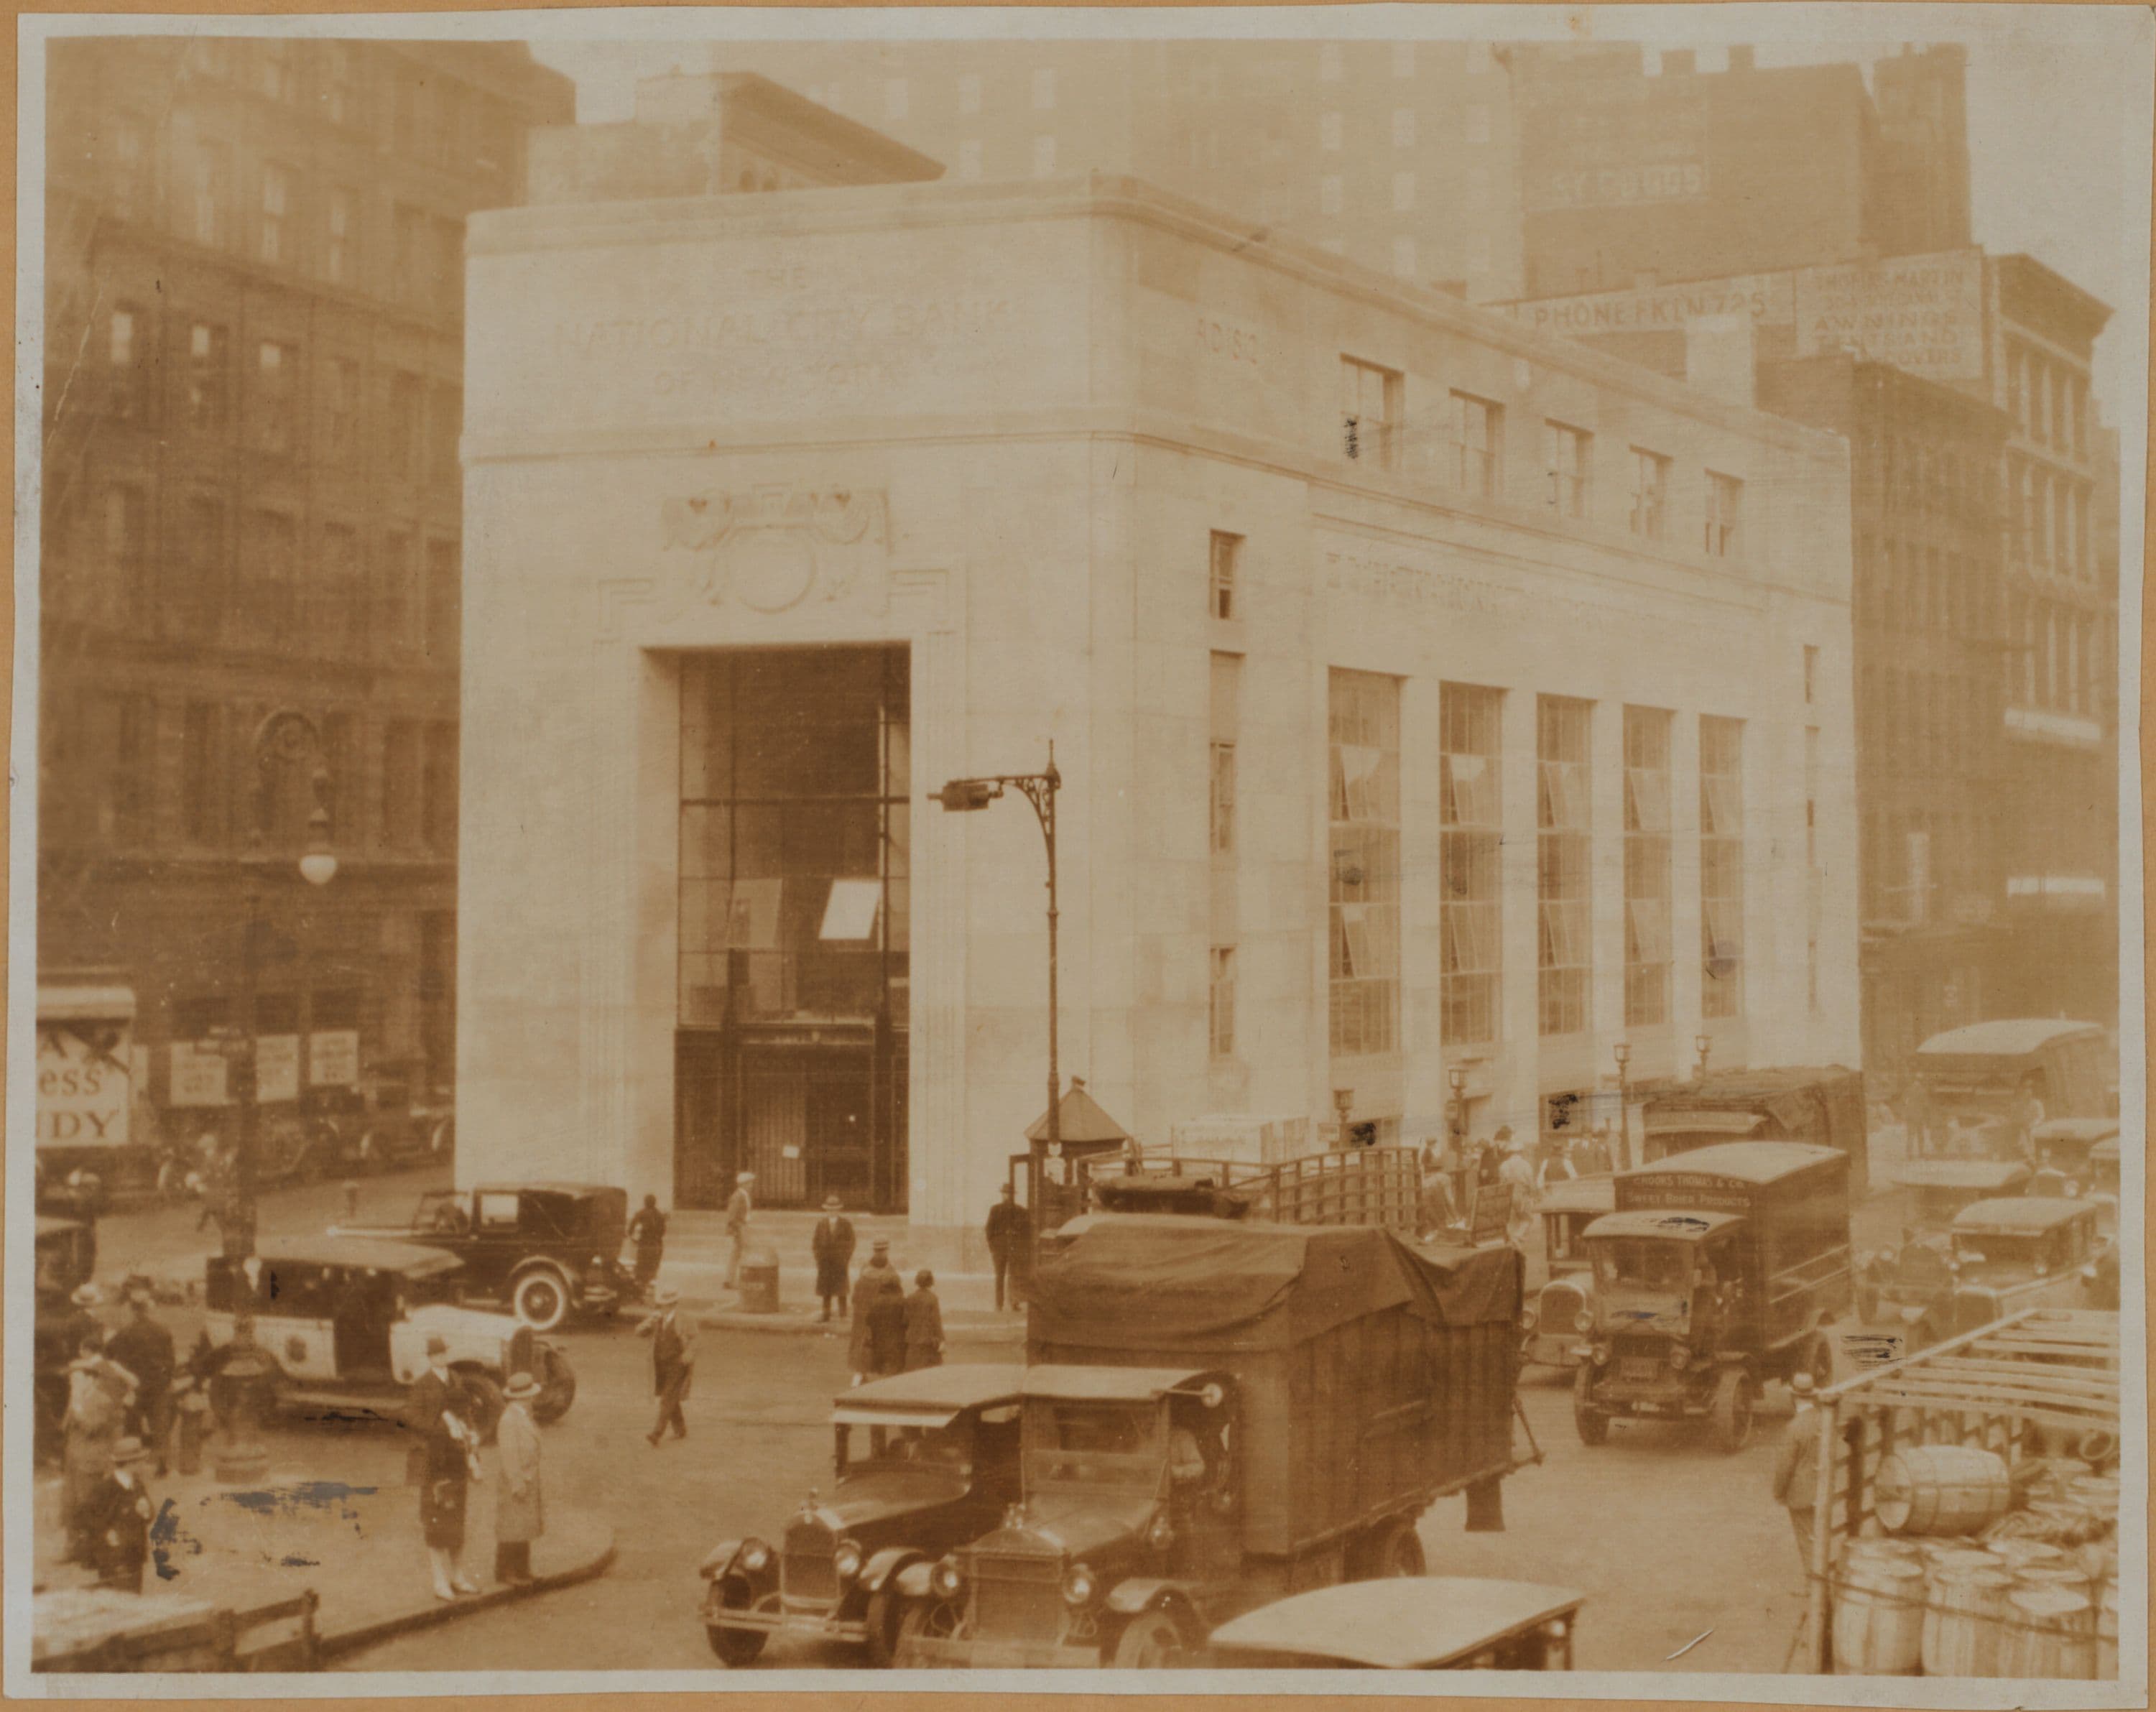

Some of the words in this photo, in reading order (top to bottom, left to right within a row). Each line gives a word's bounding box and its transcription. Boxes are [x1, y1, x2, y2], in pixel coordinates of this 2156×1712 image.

[746, 266, 806, 290] THE
[554, 314, 767, 356] NATIONAL
[894, 299, 1009, 338] BANK
[1535, 300, 1624, 328] PHONE
[39, 1068, 101, 1096] ess
[36, 1109, 120, 1139] DY
[1677, 1175, 1713, 1188] THOMAS
[1716, 1178, 1724, 1188] &
